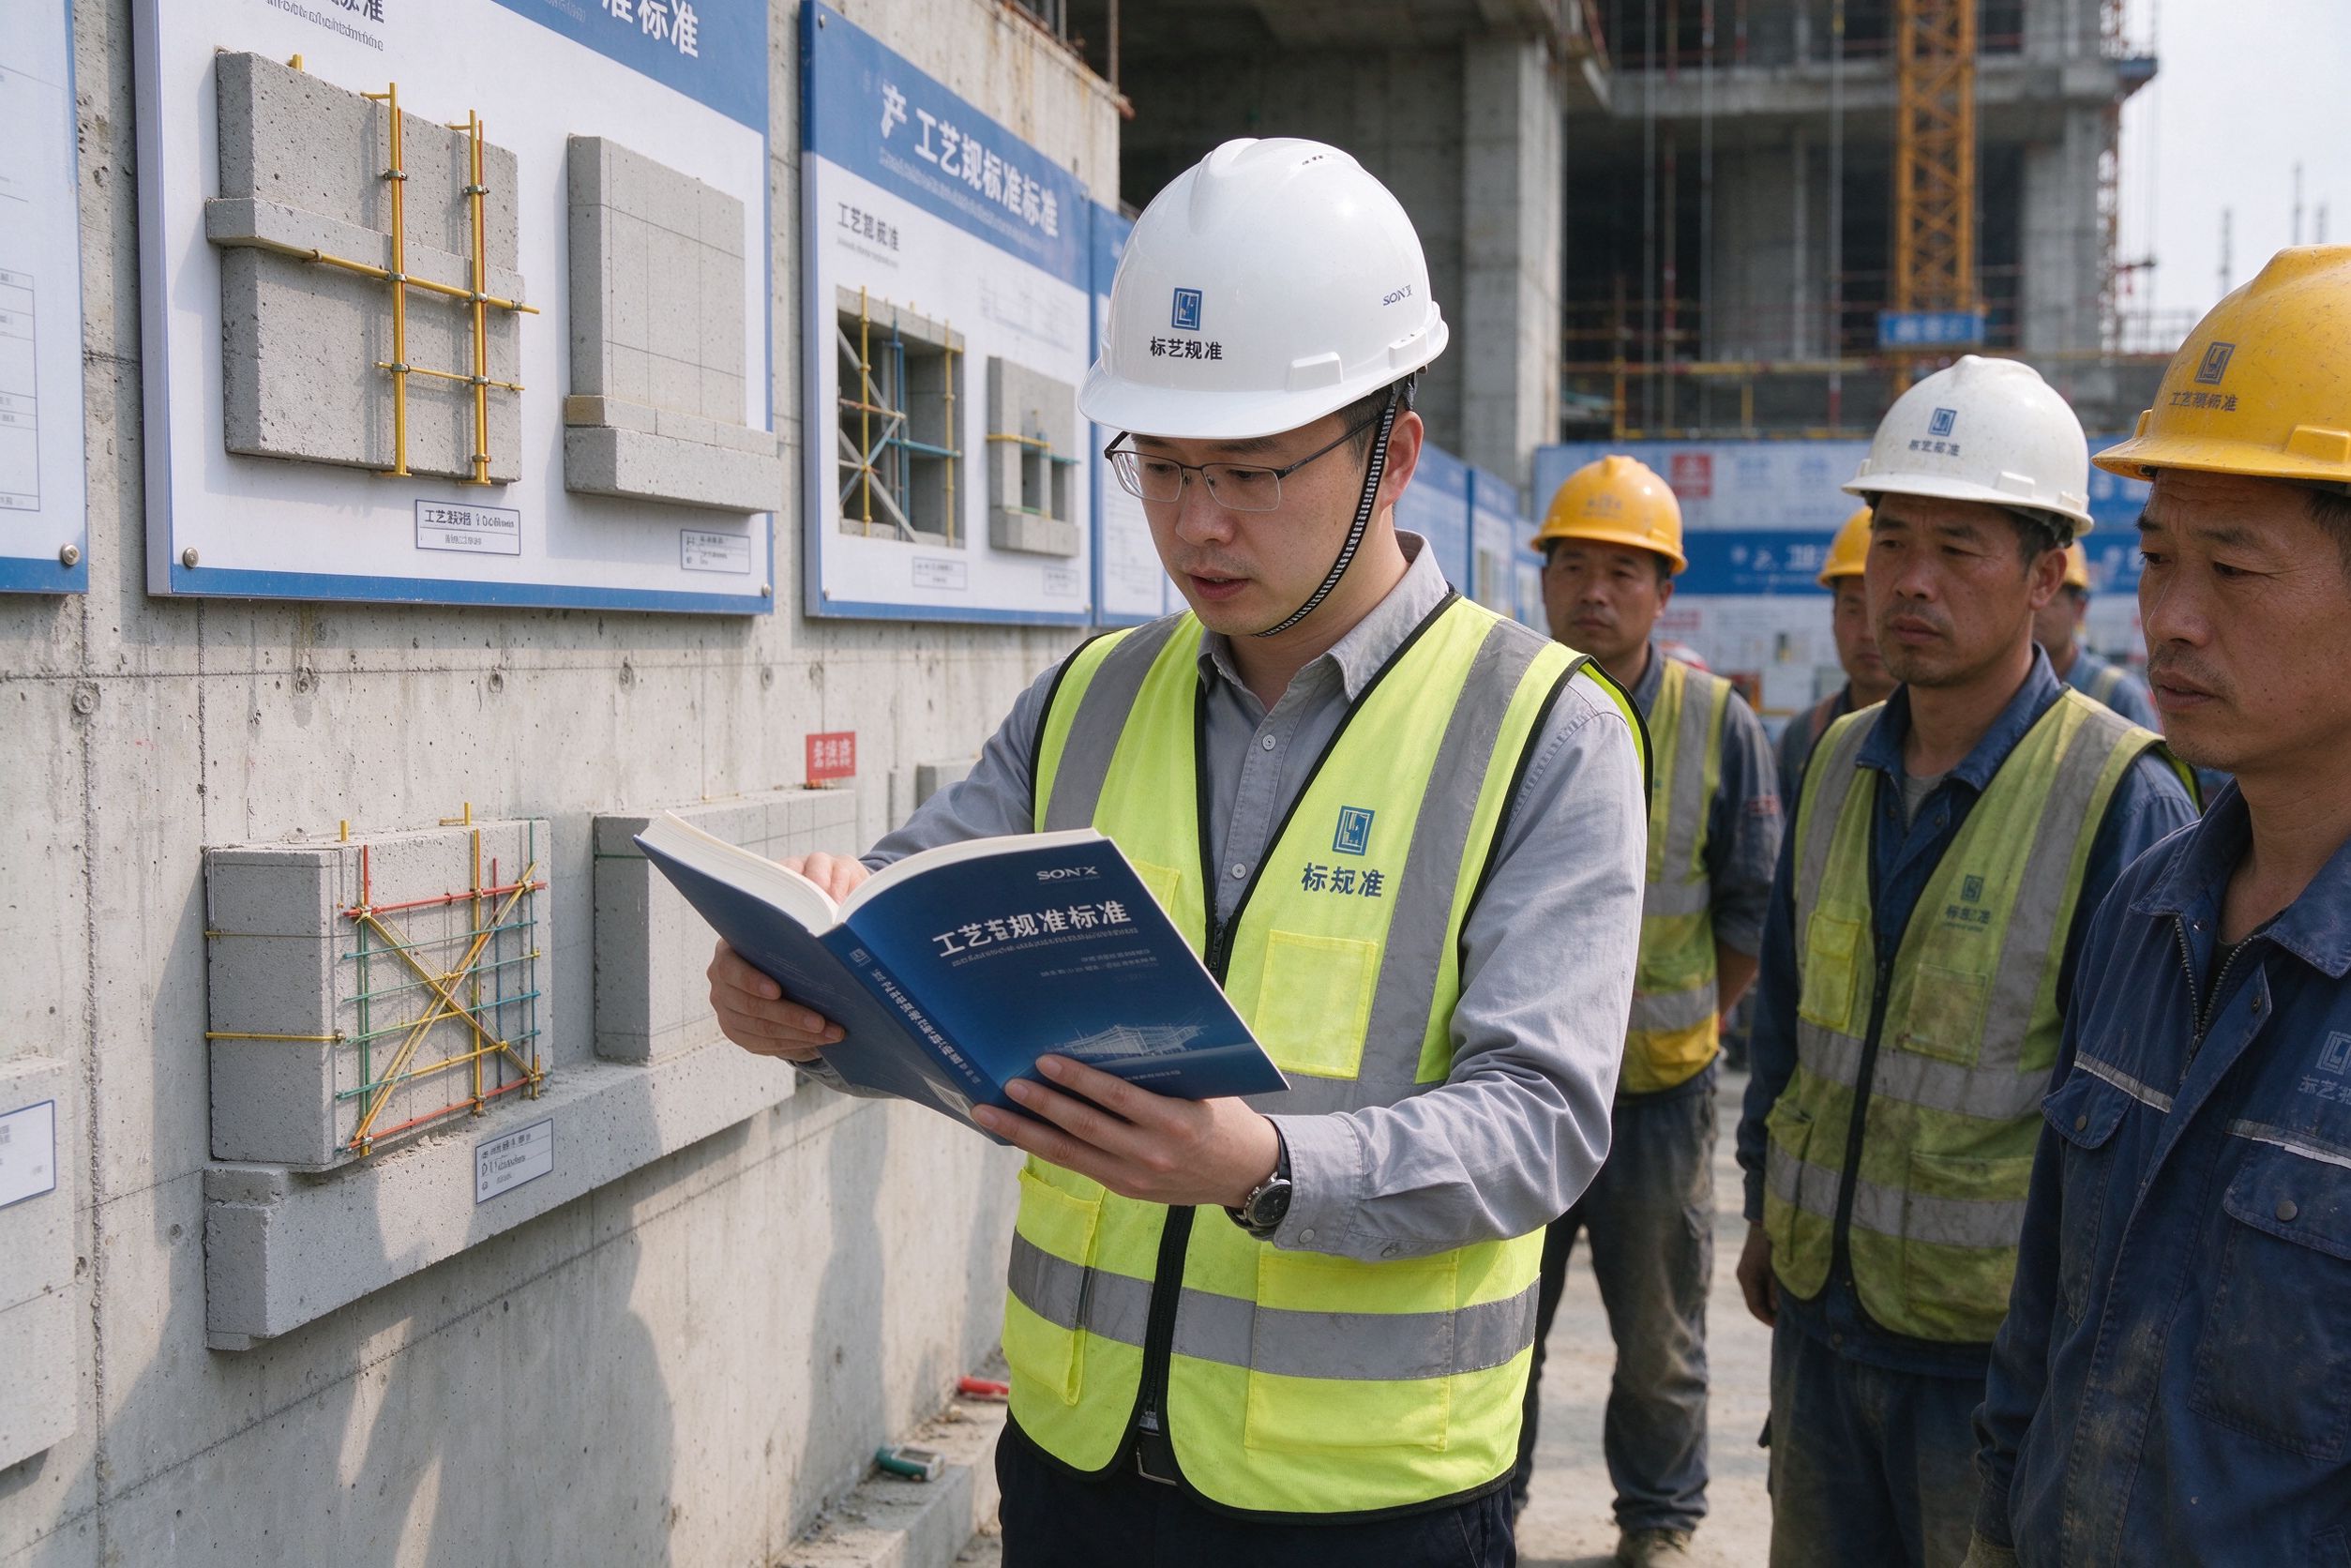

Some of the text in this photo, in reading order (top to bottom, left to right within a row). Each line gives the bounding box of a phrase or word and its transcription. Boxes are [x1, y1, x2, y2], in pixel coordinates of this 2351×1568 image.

[1150, 336, 1223, 360] 标艺规准
[1301, 862, 1385, 897] 标规准
